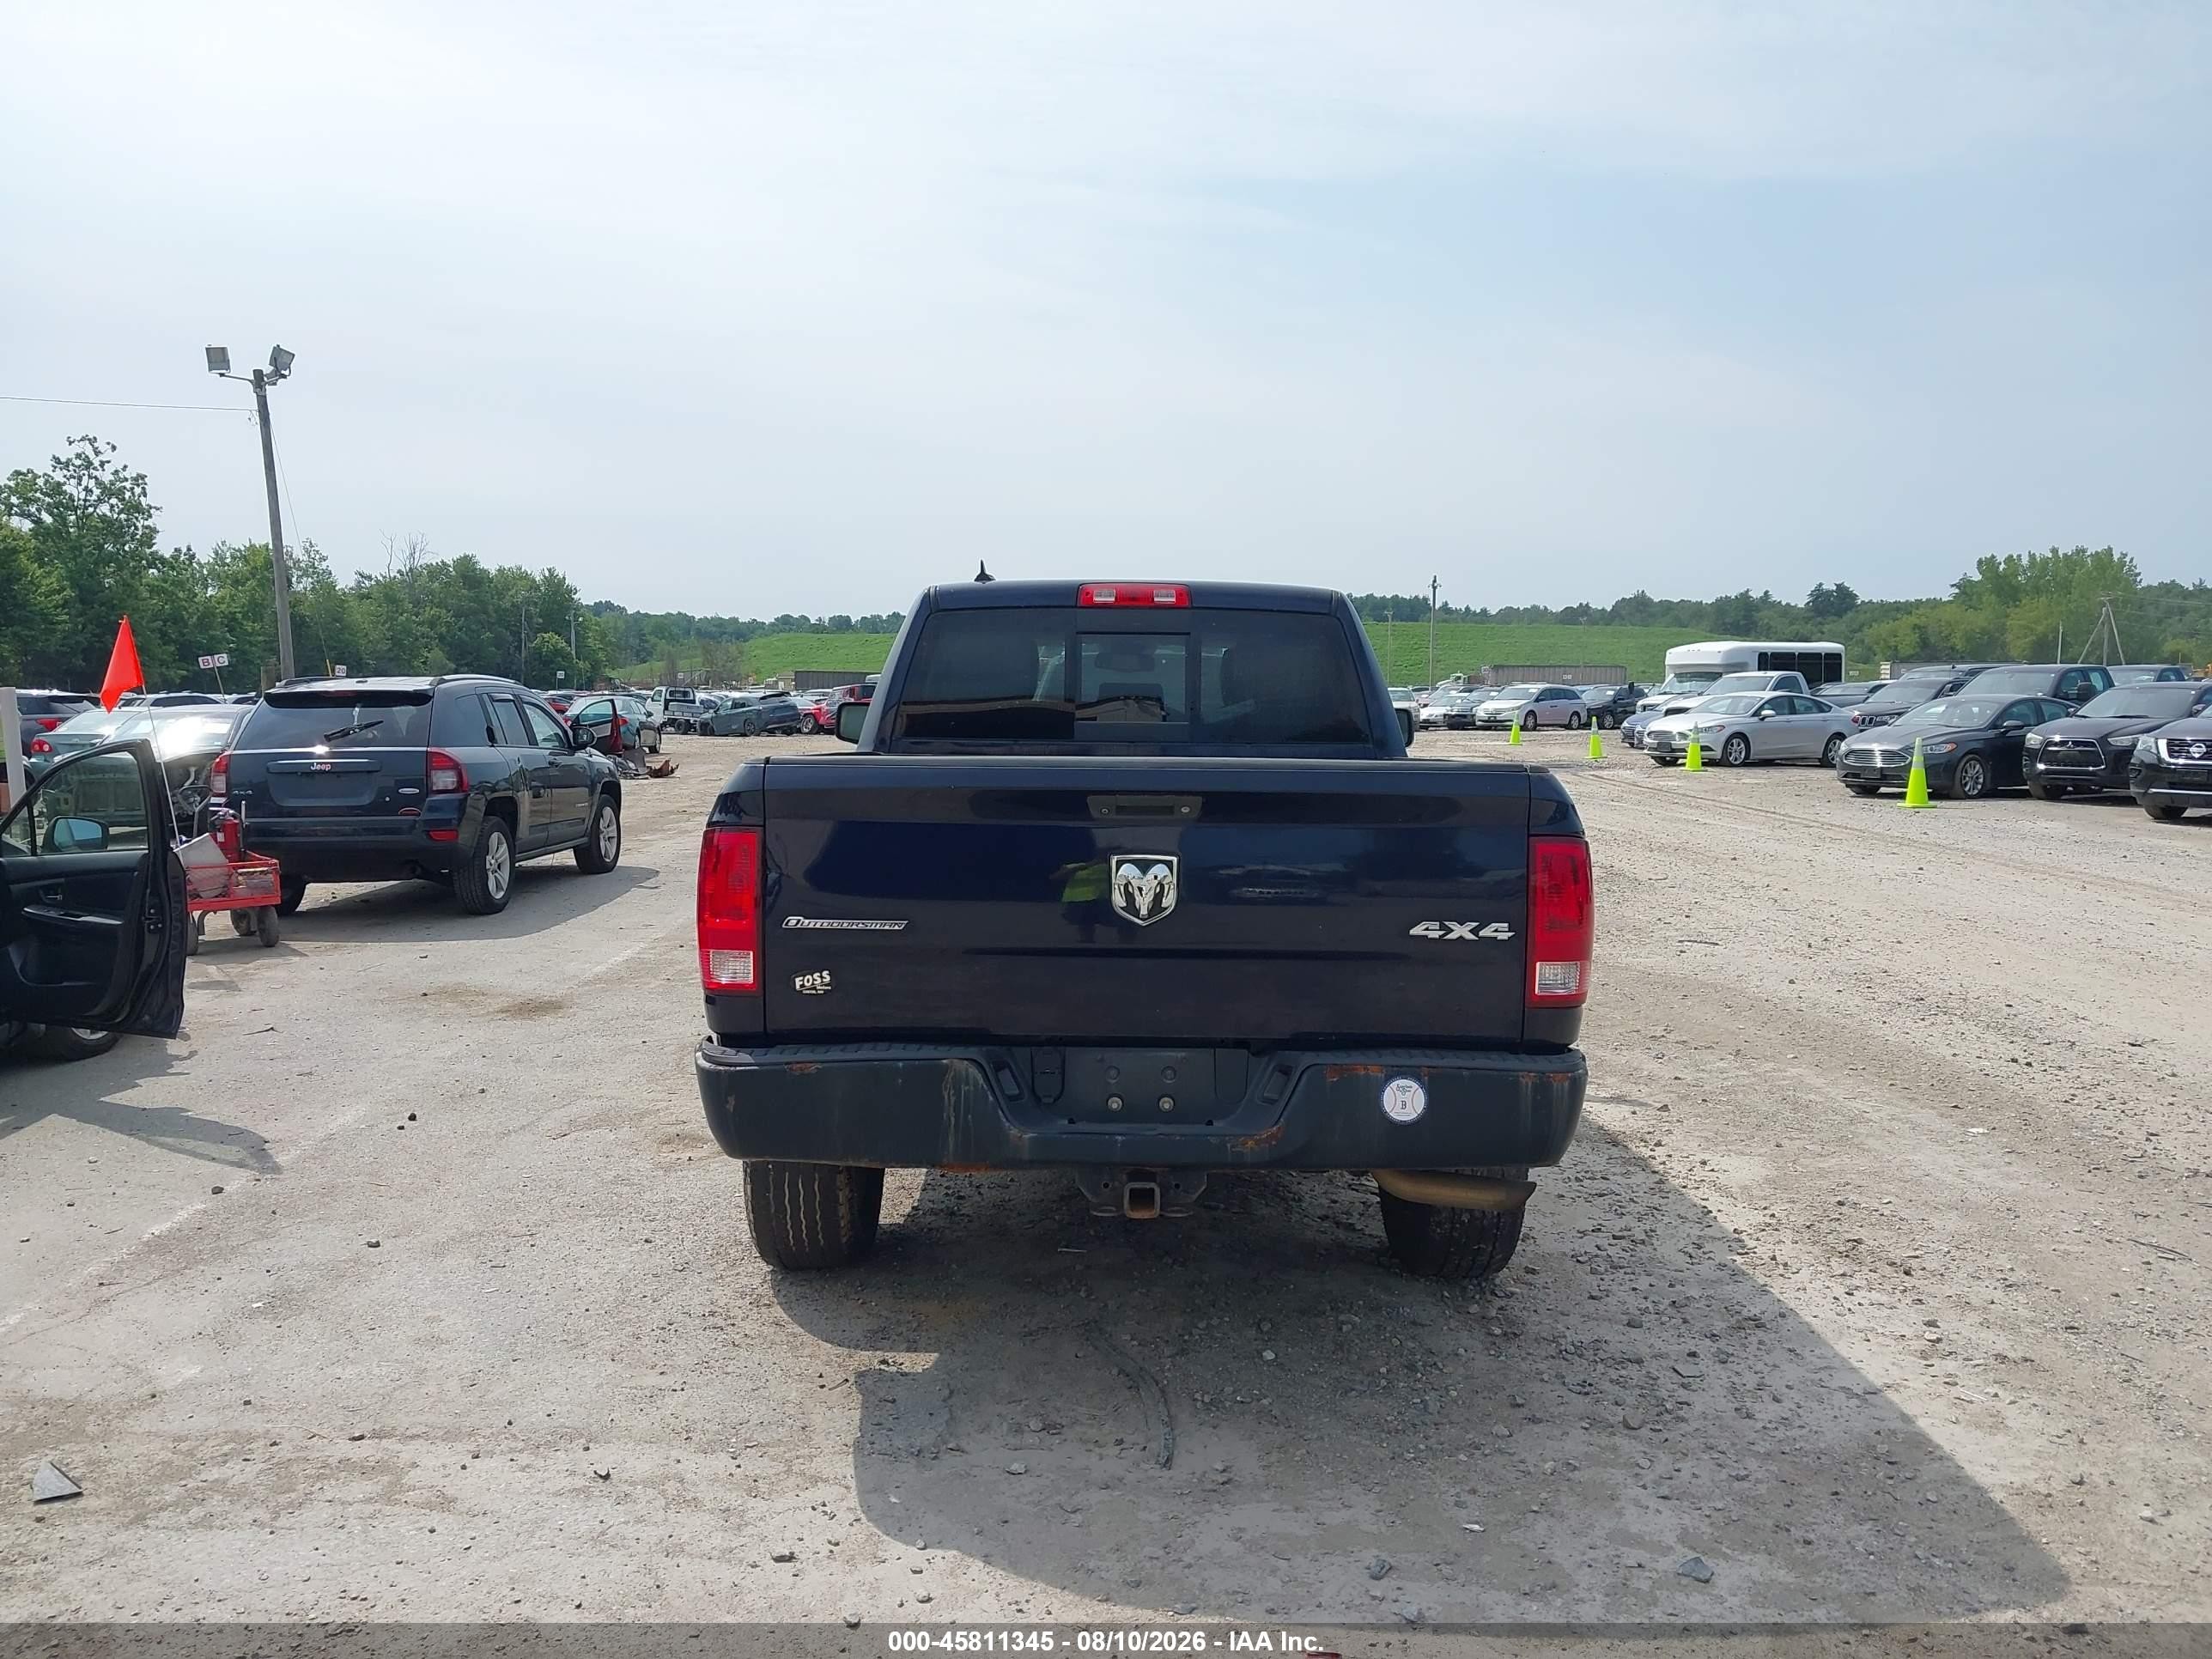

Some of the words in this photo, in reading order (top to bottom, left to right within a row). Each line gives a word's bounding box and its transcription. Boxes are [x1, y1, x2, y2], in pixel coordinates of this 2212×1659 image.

[201, 658, 211, 667] B
[216, 655, 227, 665] C
[310, 762, 331, 771] Jeep
[794, 970, 831, 989] FOSS
[1400, 1100, 1407, 1110] B
